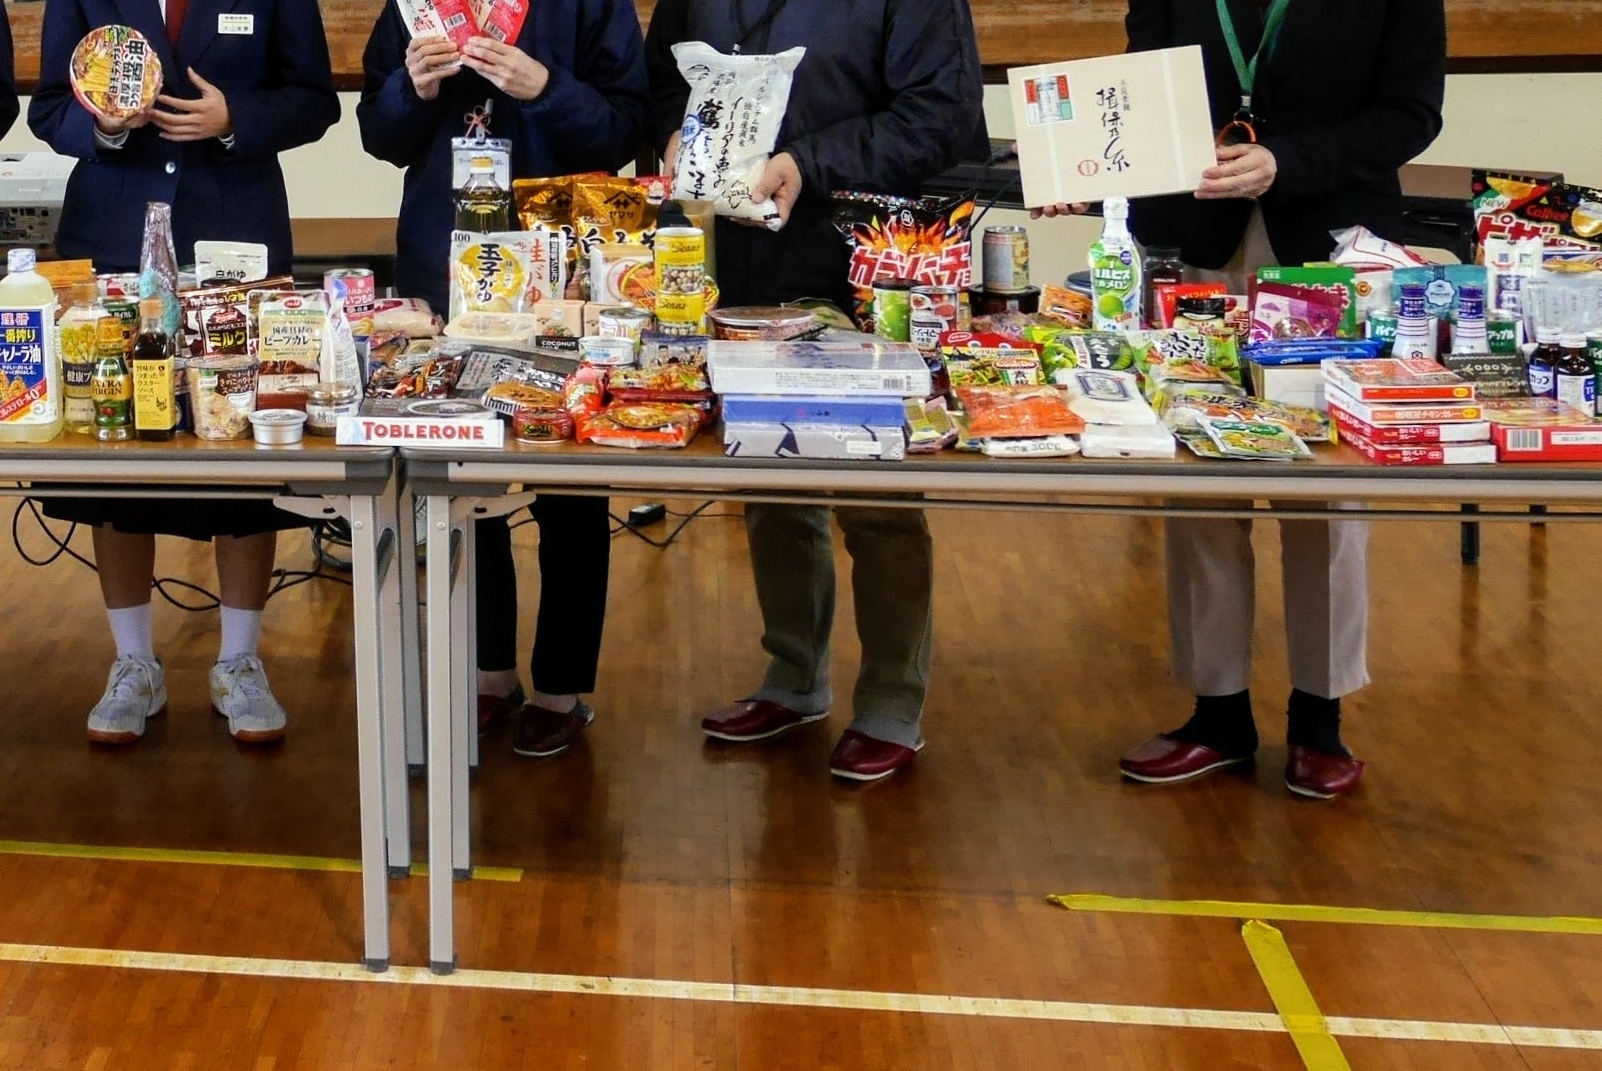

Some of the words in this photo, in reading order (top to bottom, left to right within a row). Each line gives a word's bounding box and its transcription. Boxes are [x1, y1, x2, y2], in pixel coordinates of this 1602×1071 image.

[1481, 197, 1510, 209] NEW
[609, 210, 635, 219] ヤマサ
[453, 233, 471, 243] 100
[216, 270, 246, 279] 白がゆ
[264, 336, 322, 346] ビーフカレー
[362, 421, 484, 440] TOBLERONE
